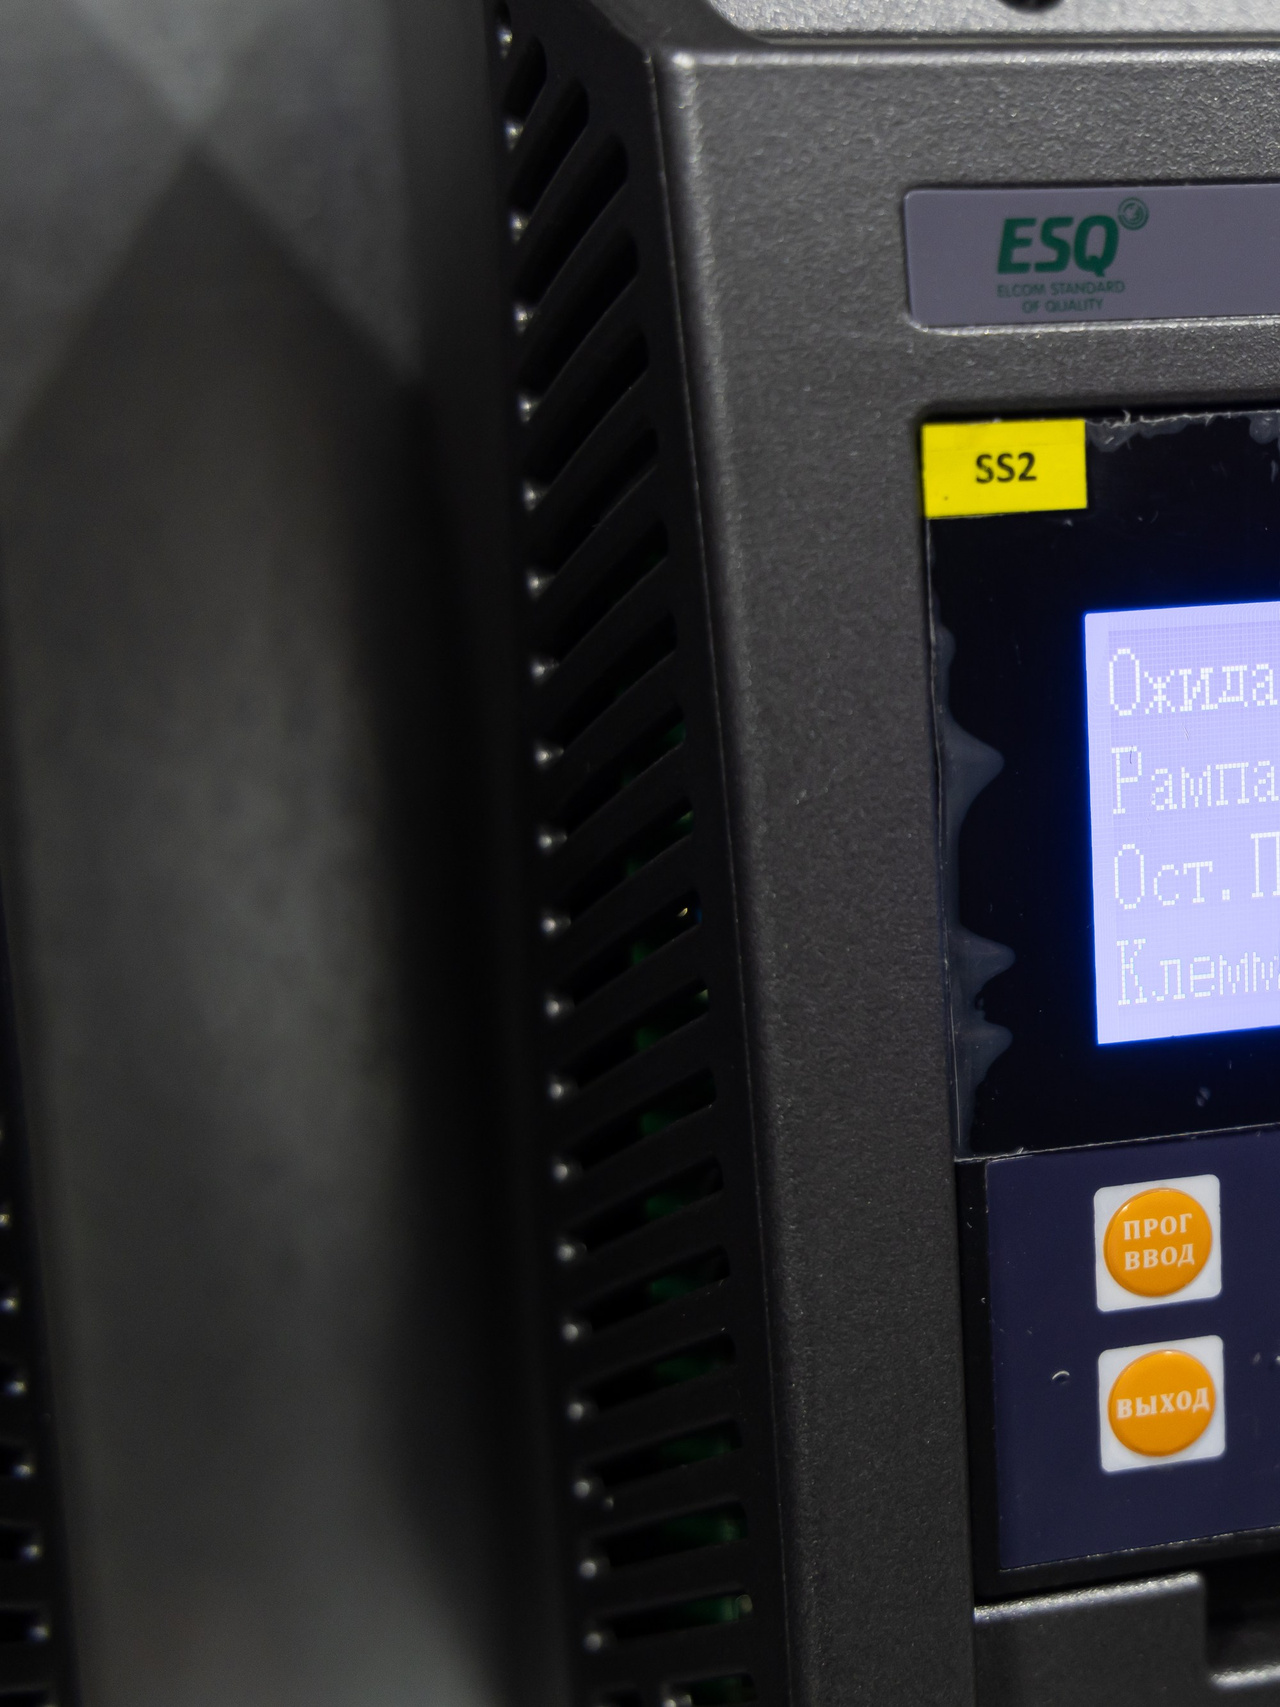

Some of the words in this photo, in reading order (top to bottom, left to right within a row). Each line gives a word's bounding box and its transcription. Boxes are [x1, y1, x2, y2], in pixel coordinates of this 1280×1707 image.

[997, 214, 1120, 277] ESQ
[997, 283, 1046, 298] ELCOM
[1050, 280, 1125, 295] STANDARD
[1022, 301, 1041, 314] OF
[1045, 298, 1104, 313] QUALITY
[975, 452, 1037, 484] SS2
[1111, 745, 1279, 814] Рампа
[1122, 1213, 1193, 1241] ПРОГ
[1124, 1244, 1195, 1271] ВВОД
[1116, 1388, 1210, 1420] ВЫХОД
